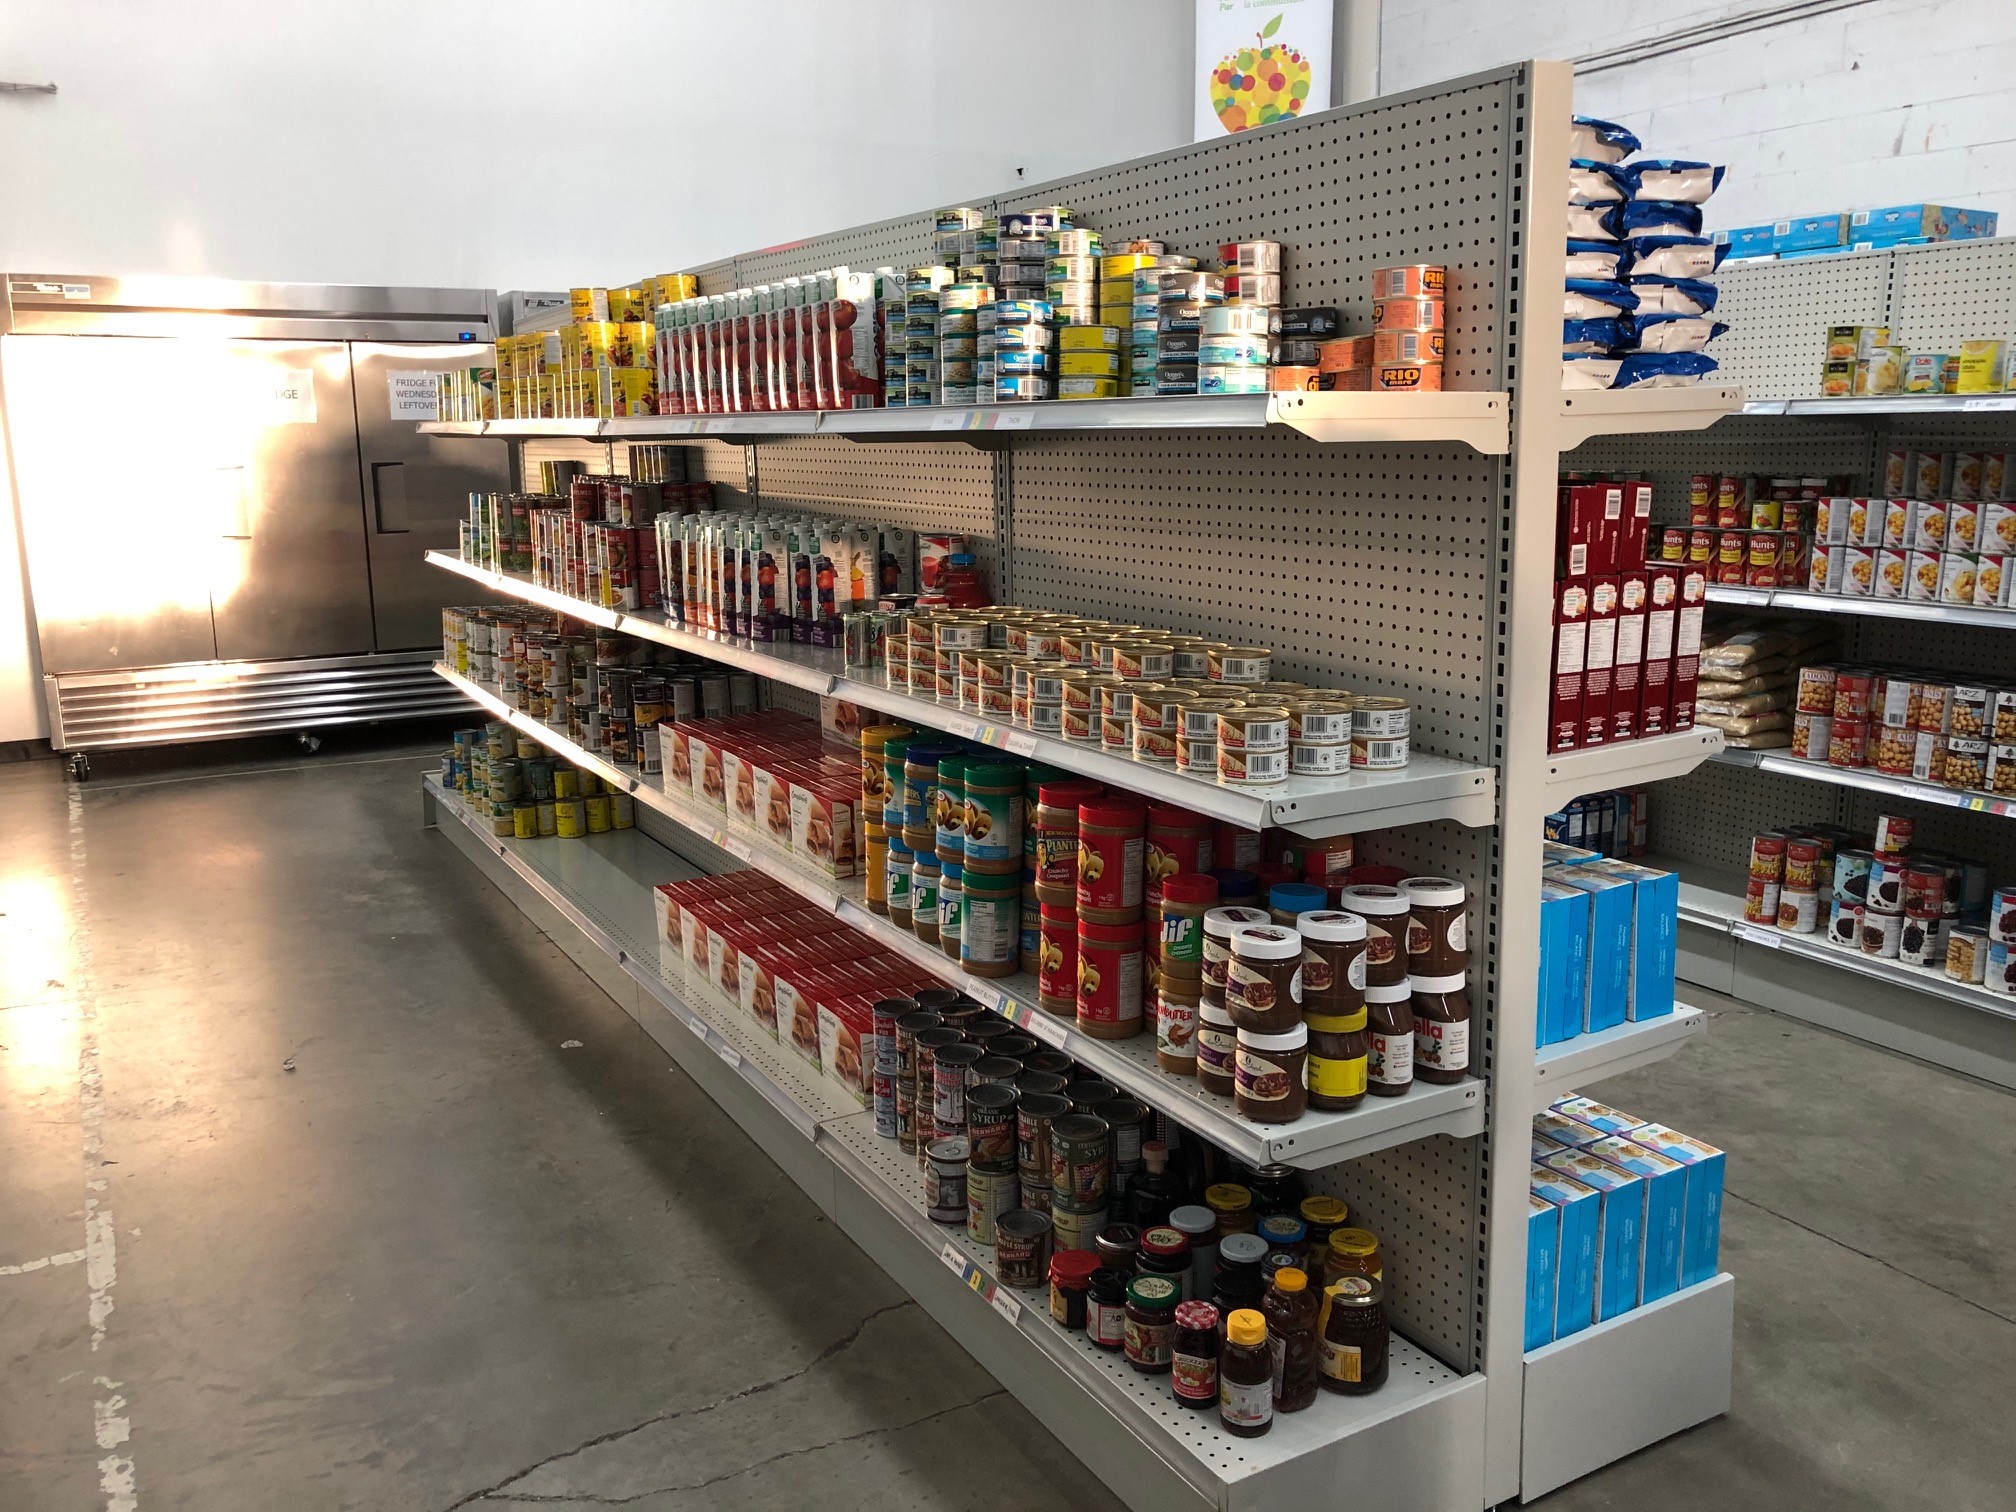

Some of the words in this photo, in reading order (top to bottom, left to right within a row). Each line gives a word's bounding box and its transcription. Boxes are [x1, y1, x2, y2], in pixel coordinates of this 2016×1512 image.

[1383, 369, 1419, 381] RIO
[396, 379, 426, 387] FRIDGE
[1751, 539, 1776, 551] Hunt's
[1959, 688, 1979, 697] ARZ
[1962, 740, 1984, 750] ARZ
[1160, 917, 1194, 943] Jif
[968, 982, 985, 996] PEANUT
[984, 991, 998, 1004] BUTTER
[1413, 1017, 1443, 1040] ella
[972, 1113, 1007, 1124] SYRUP
[972, 1124, 1007, 1136] BERNARD
[1014, 1242, 1035, 1250] SYRUP
